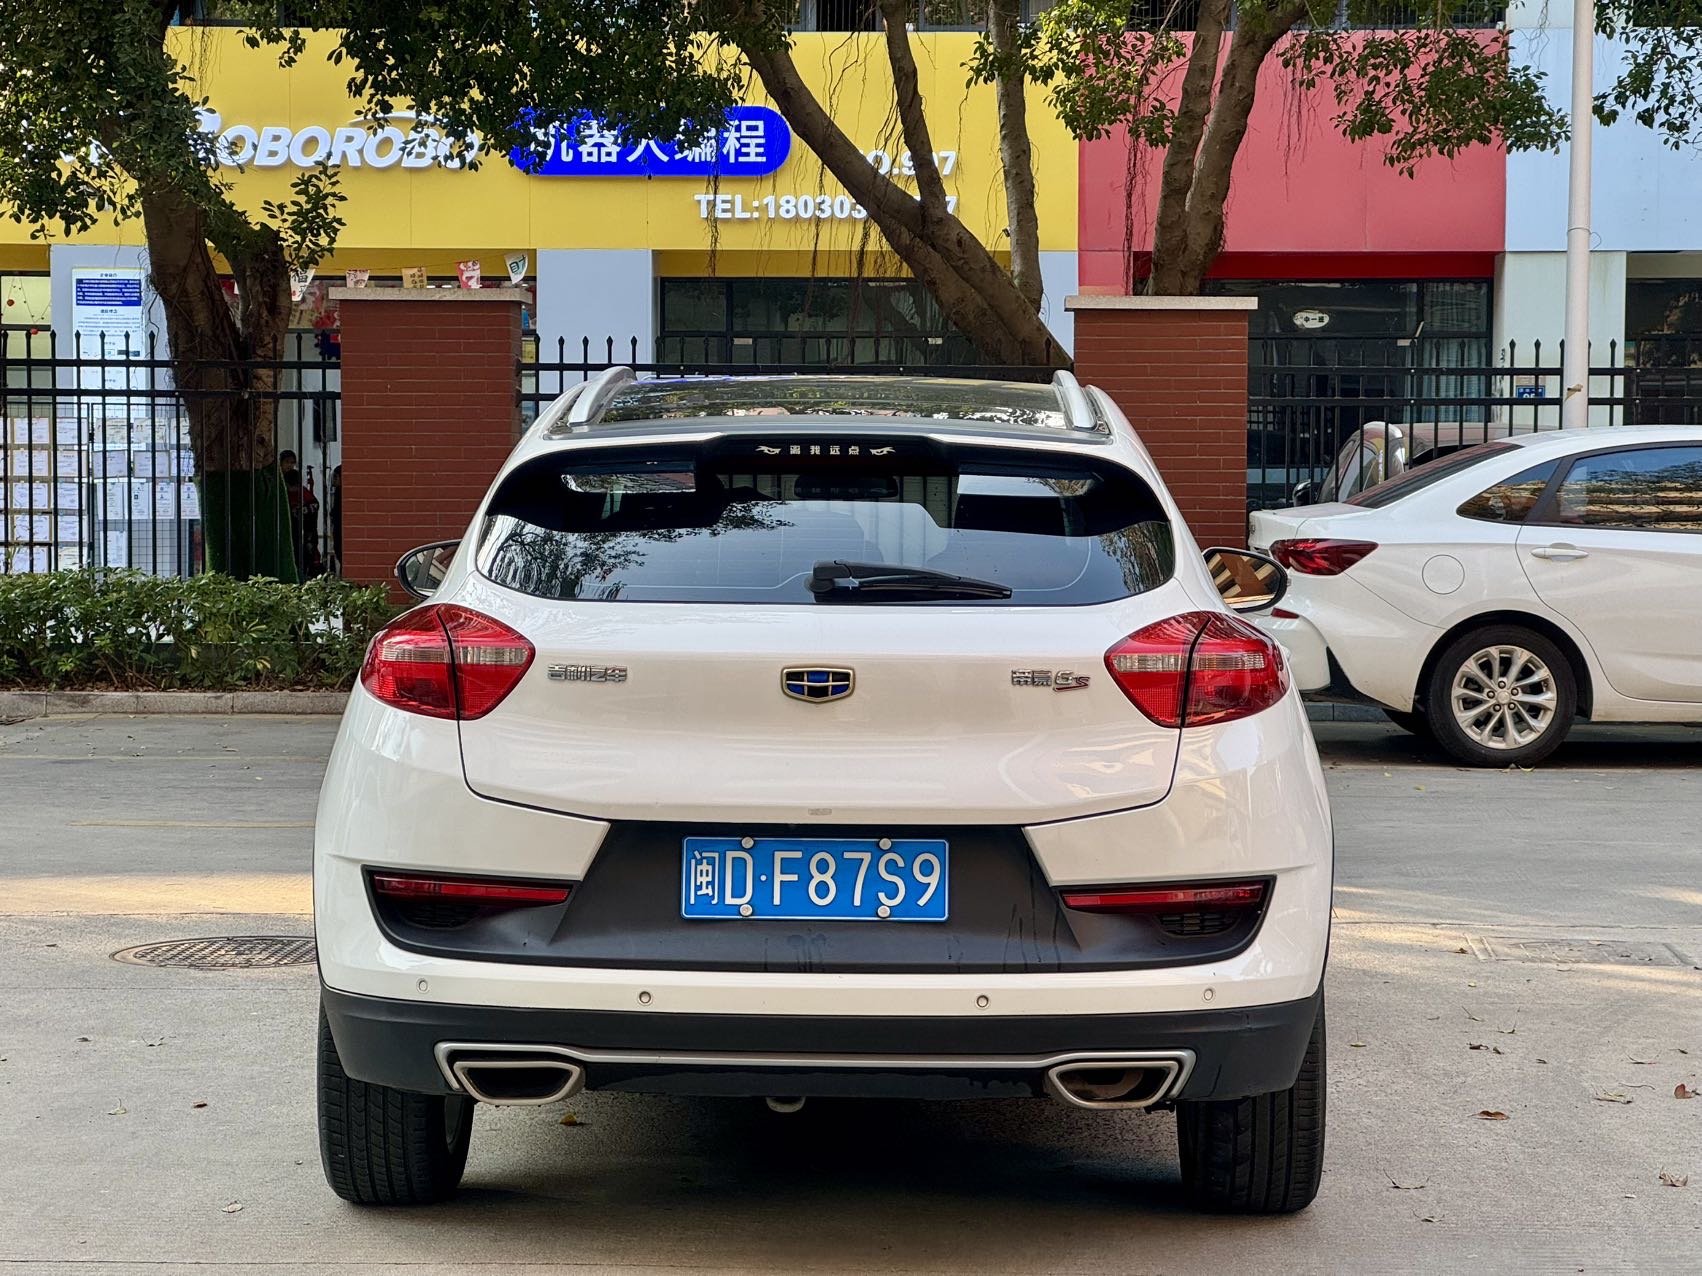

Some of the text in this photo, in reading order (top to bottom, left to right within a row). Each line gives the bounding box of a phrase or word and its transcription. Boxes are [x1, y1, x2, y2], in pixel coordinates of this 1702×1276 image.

[694, 194, 957, 219] TEL:1803037
[548, 664, 628, 682] 吉利汽车
[689, 850, 942, 907] 闽D·F87S9
